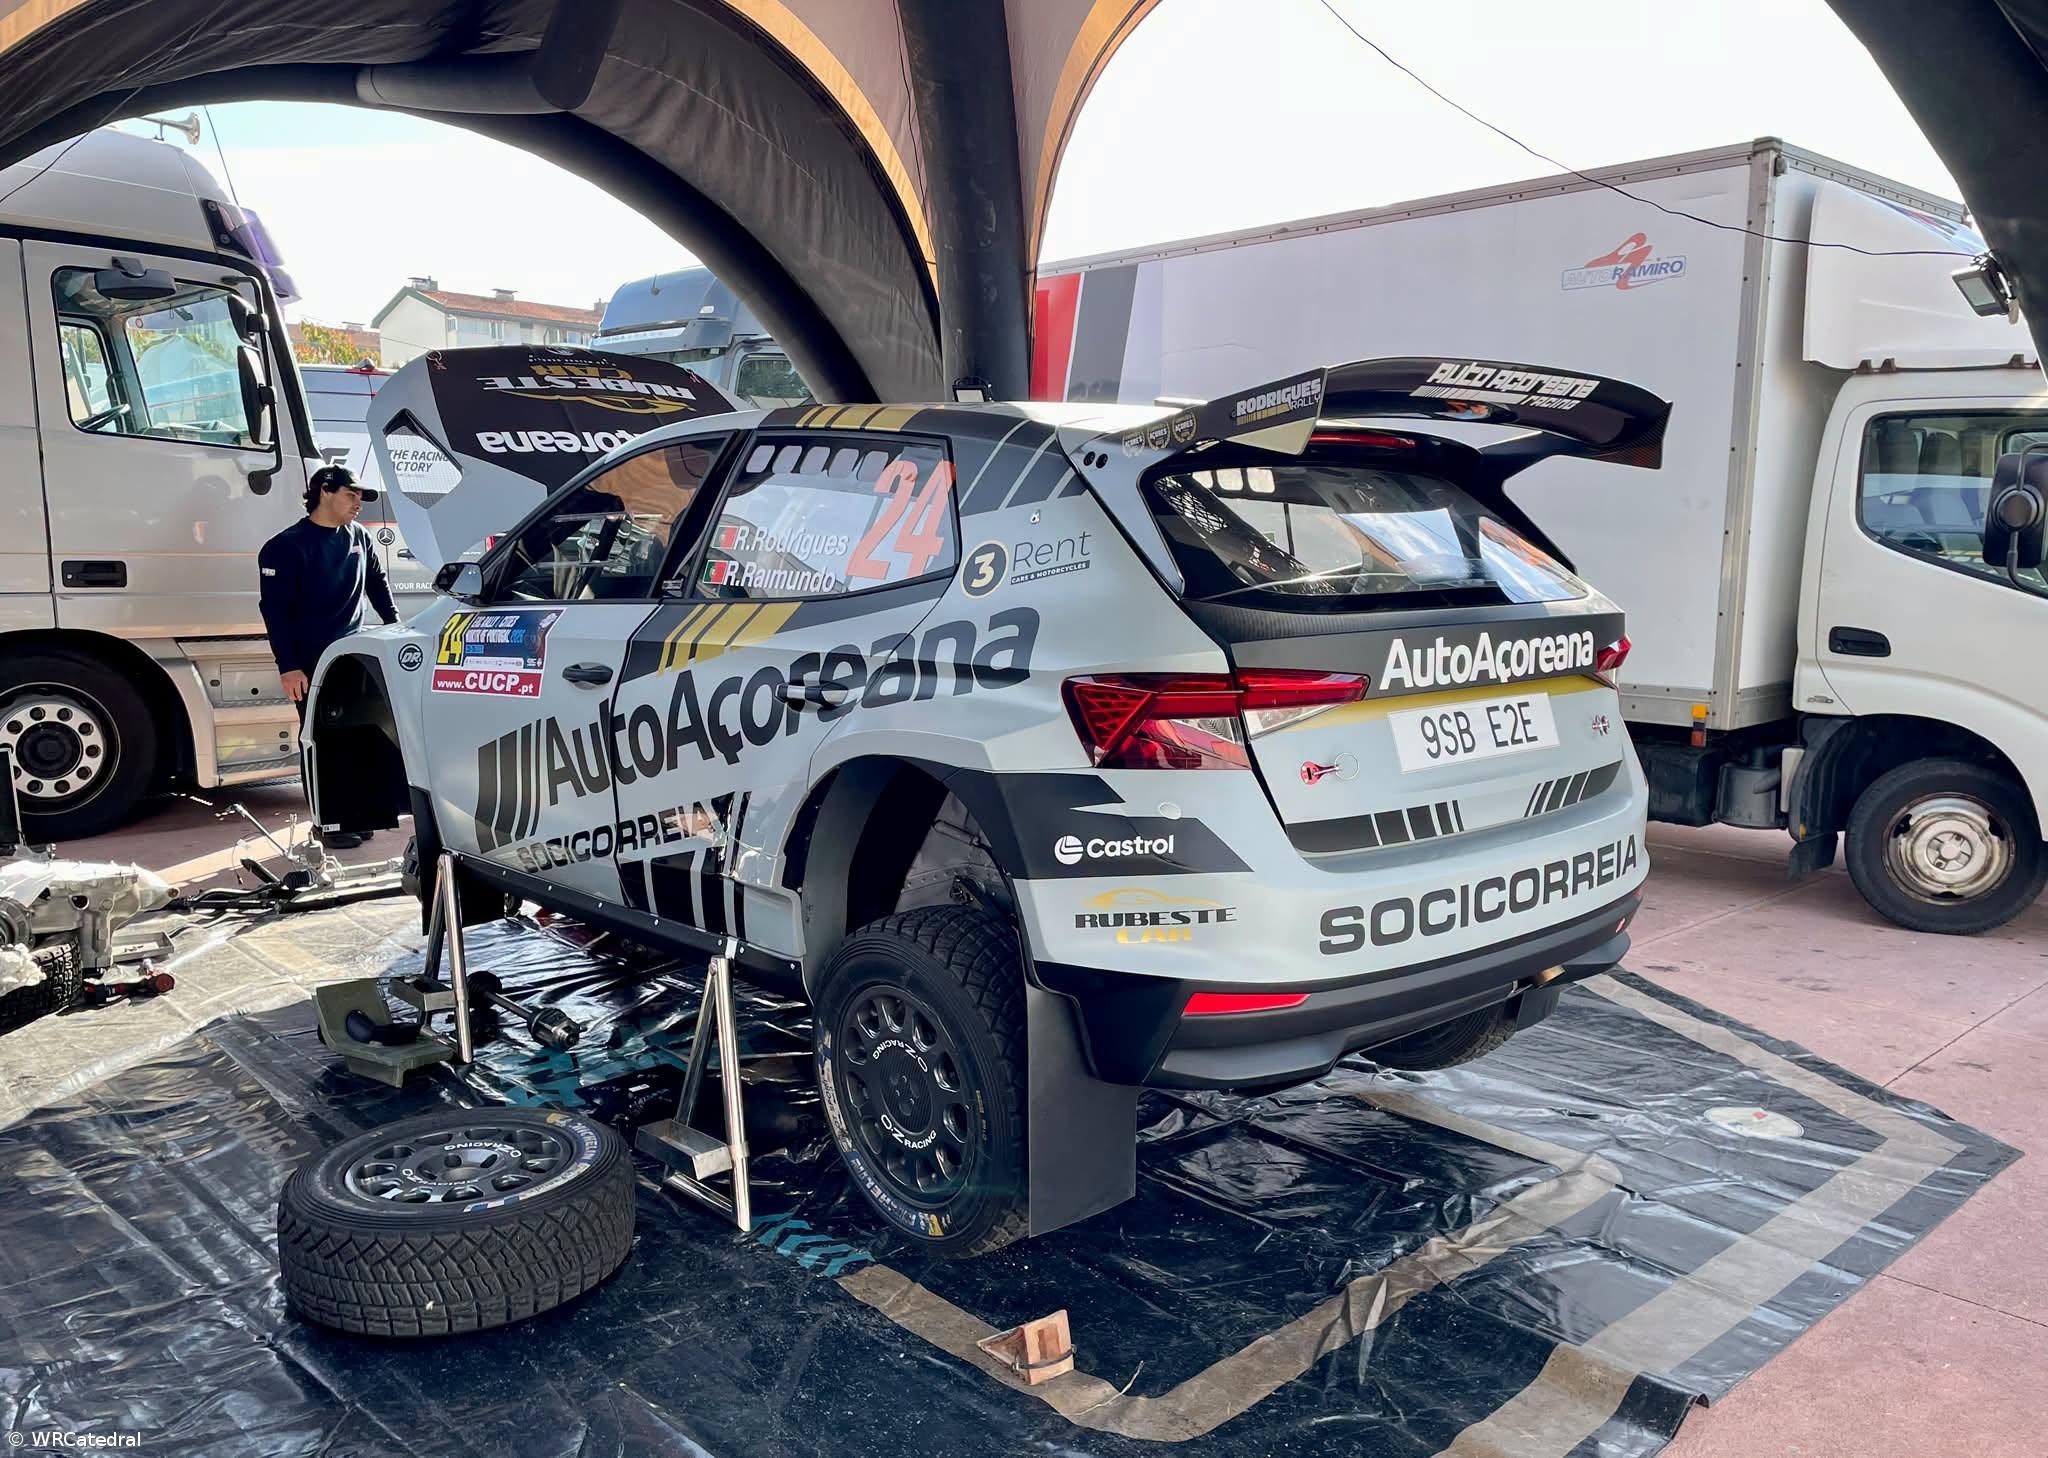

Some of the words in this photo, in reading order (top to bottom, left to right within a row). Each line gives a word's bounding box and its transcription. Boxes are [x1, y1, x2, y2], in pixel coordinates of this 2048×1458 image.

[476, 375, 697, 401] RUBESTE
[528, 364, 633, 381] CAR
[1236, 378, 1321, 417] RODRIGUES
[1291, 393, 1321, 410] RALLY
[846, 459, 957, 581] 24
[732, 525, 849, 557] R.Rodrigues
[1013, 531, 1092, 572] Rent
[394, 582, 414, 590] YOUR
[723, 559, 836, 593] R.Raimundo
[1011, 575, 1029, 584] CARS
[1037, 562, 1087, 578] MOTORCYCLES
[437, 613, 475, 664] 24
[1379, 630, 1594, 691] AutoAçoreana
[437, 672, 534, 695] www.CUCP.pt
[546, 605, 1041, 807] AutoAçoreana
[1420, 710, 1477, 759] 9SB
[1490, 700, 1539, 749] E2E
[515, 800, 716, 874] SOCICORREIA
[1087, 834, 1174, 858] Castrol
[1319, 834, 1638, 955] SOCICORREIA
[1075, 907, 1237, 929] RUBESTE
[1116, 928, 1192, 945] CAR
[872, 1040, 905, 1060] RACING
[568, 1122, 598, 1160] MICHELIN
[904, 1130, 937, 1149] RACING
